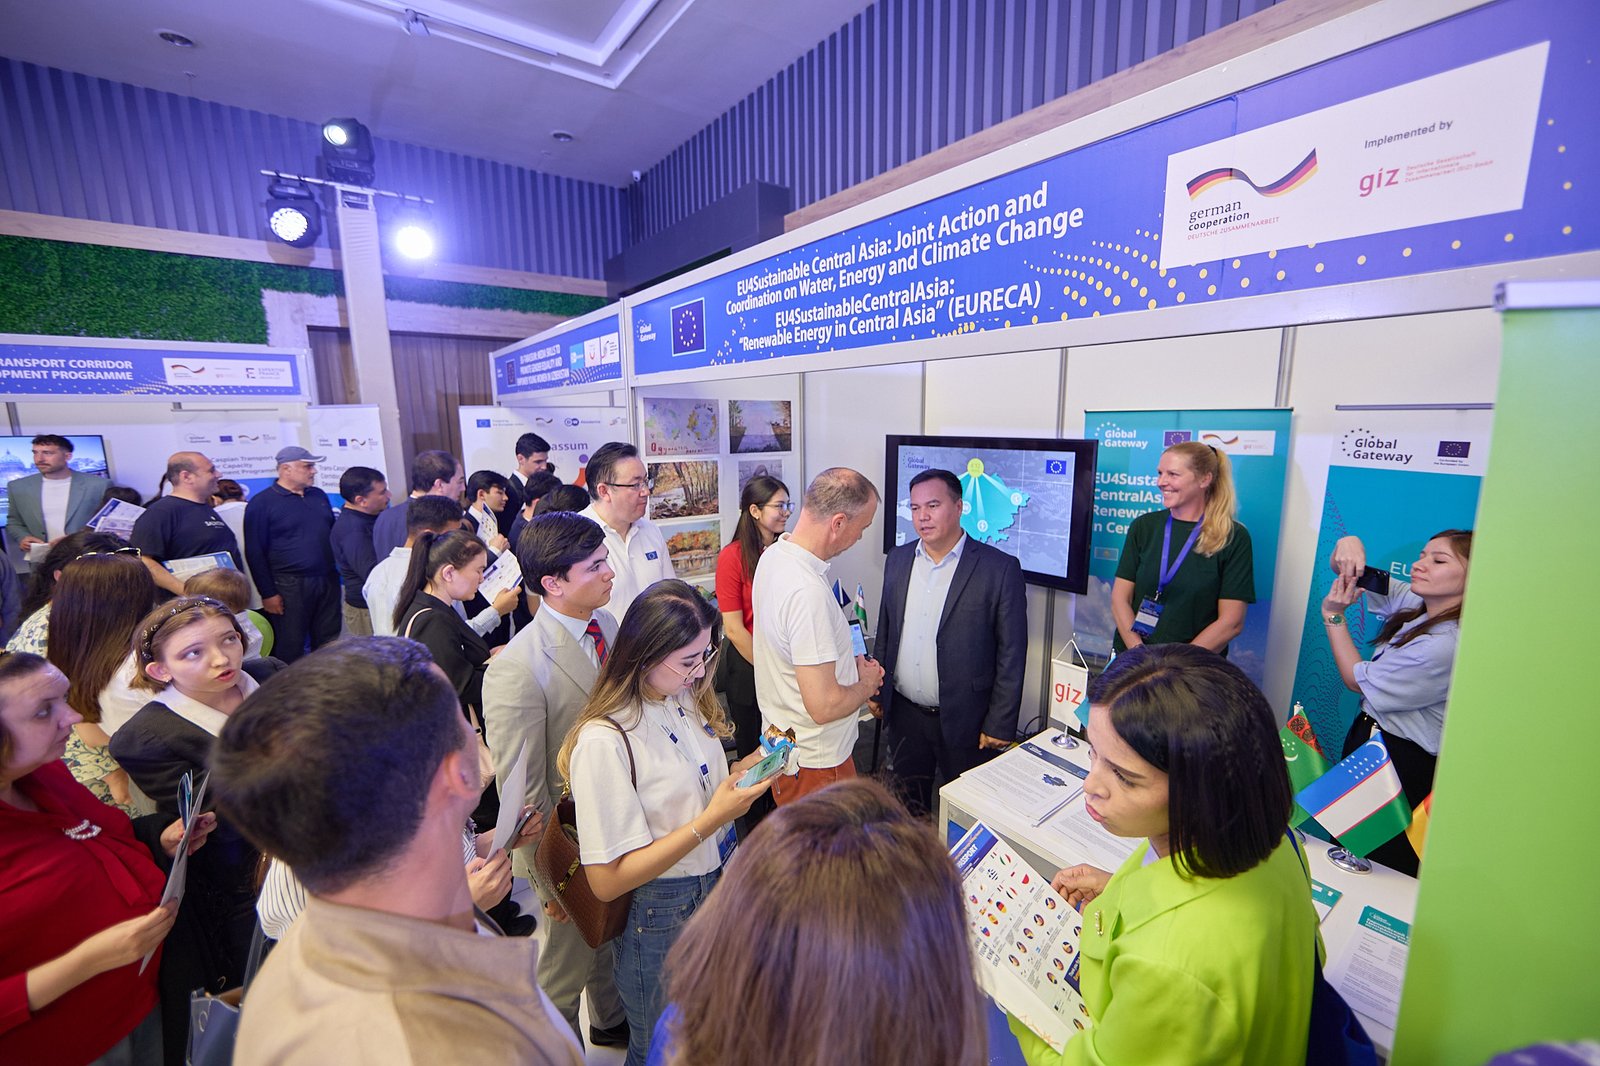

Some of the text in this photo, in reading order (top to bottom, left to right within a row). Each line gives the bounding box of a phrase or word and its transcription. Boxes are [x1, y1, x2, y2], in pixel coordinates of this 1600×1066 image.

[1364, 120, 1454, 149] Implemented by
[1359, 168, 1400, 198] giz
[1188, 201, 1241, 224] german
[1187, 216, 1280, 241] DEUTSCHE ZUSAMMENARBEIT
[1188, 212, 1250, 231] cooperation
[737, 181, 1048, 297] EU4Sustainable Central Asia: Joint Action and
[726, 207, 1084, 316] Coordination on Water, Energy and Climate Change
[775, 277, 955, 329] EU4SustainableCentralAsia:
[794, 324, 832, 345] Energy
[834, 320, 847, 338] in
[849, 308, 899, 336] Central
[948, 280, 1041, 322] (EURECA)
[68, 359, 133, 370] CORRIDOR
[0, 369, 134, 381] PMENT PROGRAMME
[1104, 429, 1137, 439] Global
[549, 441, 589, 452] assum
[1104, 440, 1149, 450] Gateway
[1354, 438, 1398, 449] Global
[907, 455, 925, 464] Global
[1352, 449, 1414, 465] Gateway
[241, 468, 277, 476] Programm
[1095, 472, 1160, 487] EU4Susta
[1094, 488, 1164, 504] CentralAs
[1093, 522, 1103, 532] n
[1055, 683, 1082, 705] giz
